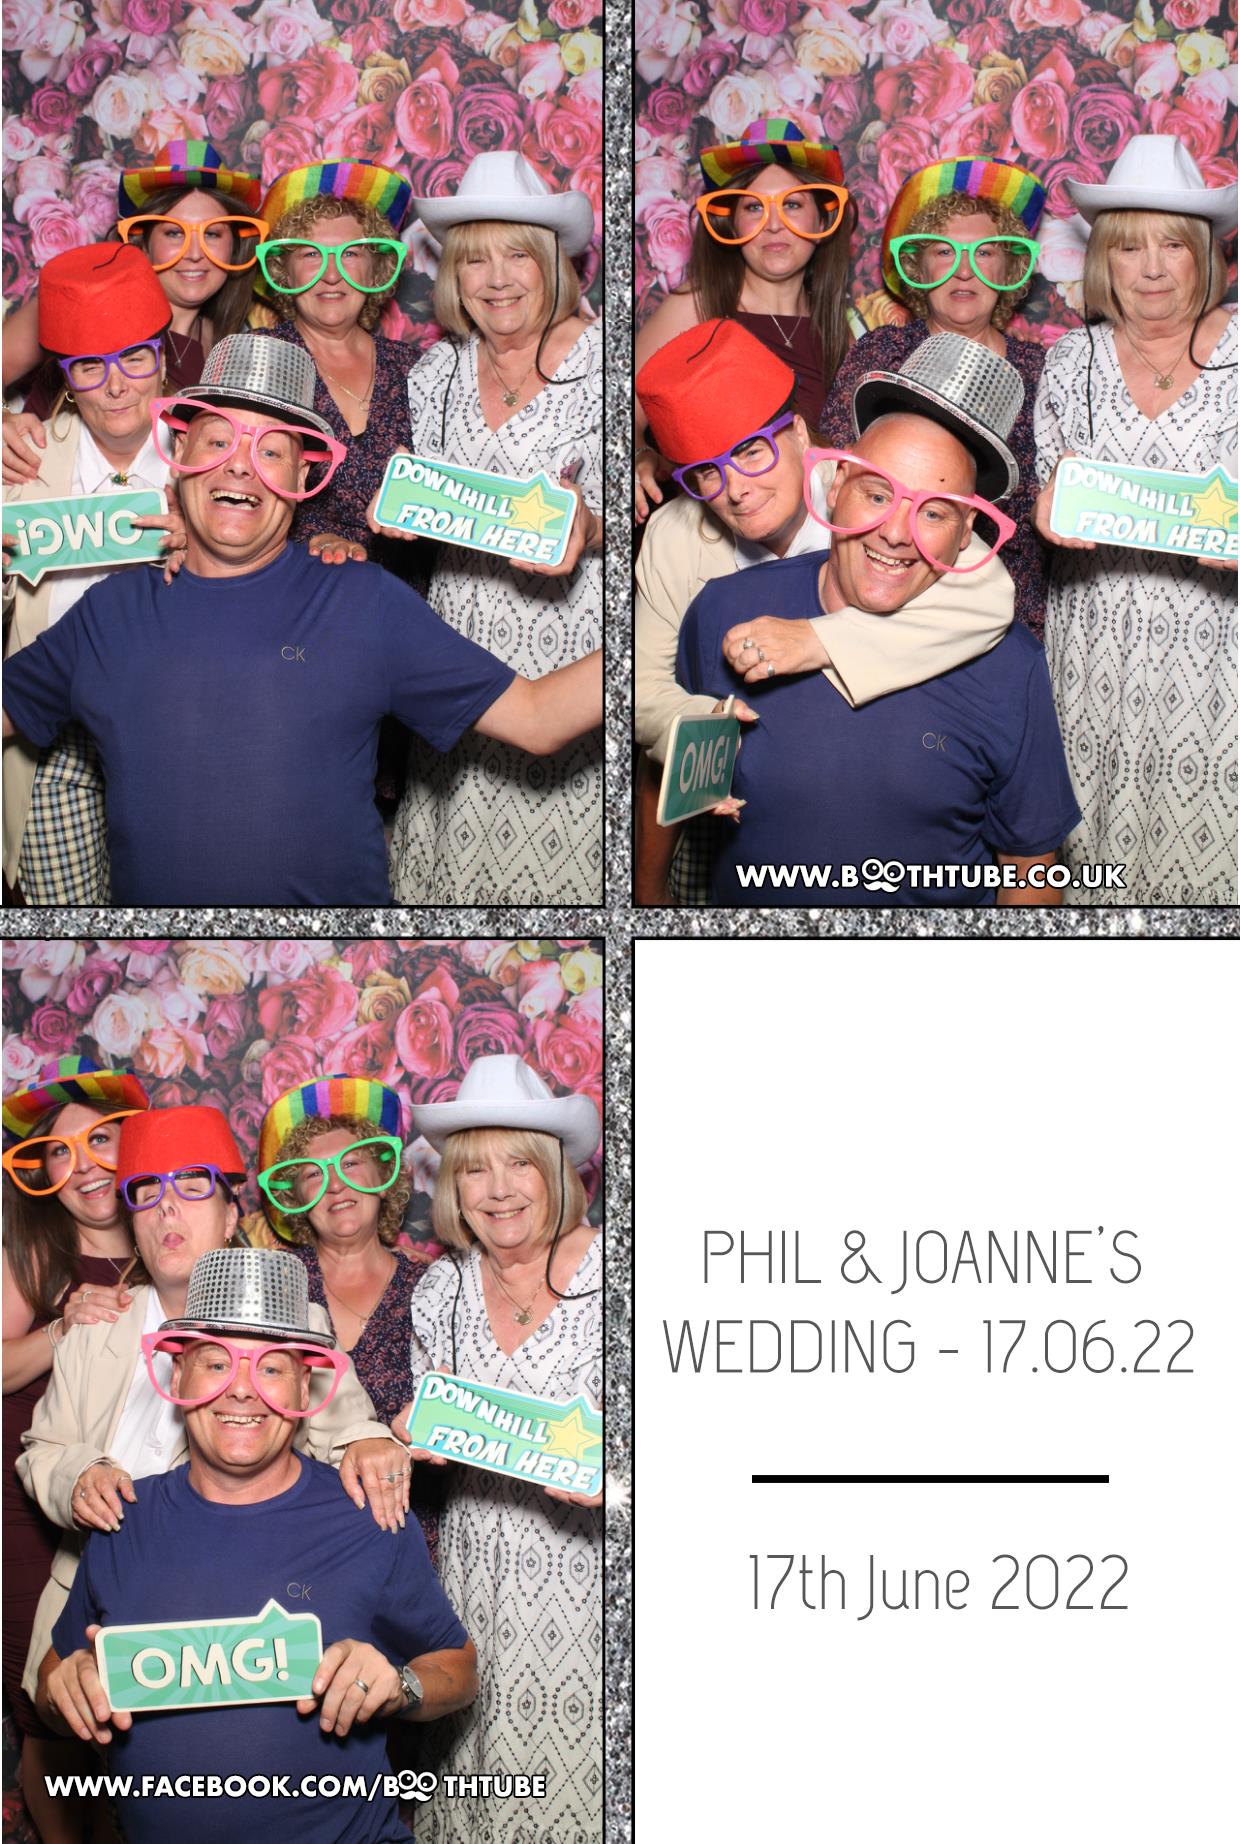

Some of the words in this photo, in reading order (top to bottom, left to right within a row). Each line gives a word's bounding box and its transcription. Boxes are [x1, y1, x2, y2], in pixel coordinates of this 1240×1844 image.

[391, 458, 512, 518] DOWNHILL
[1063, 462, 1194, 517] DOWNHILL
[15, 509, 143, 556] OMG!
[396, 504, 474, 540] FROM
[480, 524, 559, 560] HERE
[1076, 511, 1159, 543] FROM
[1166, 524, 1239, 556] HERE
[281, 646, 306, 662] CK
[679, 735, 731, 794] OMG!
[922, 732, 949, 751] CK
[422, 1376, 549, 1444] DOWNHILL
[427, 1426, 510, 1465] FROM
[514, 1450, 599, 1490] HERE
[286, 1582, 312, 1601] CK
[131, 1637, 289, 1689] OMG!
